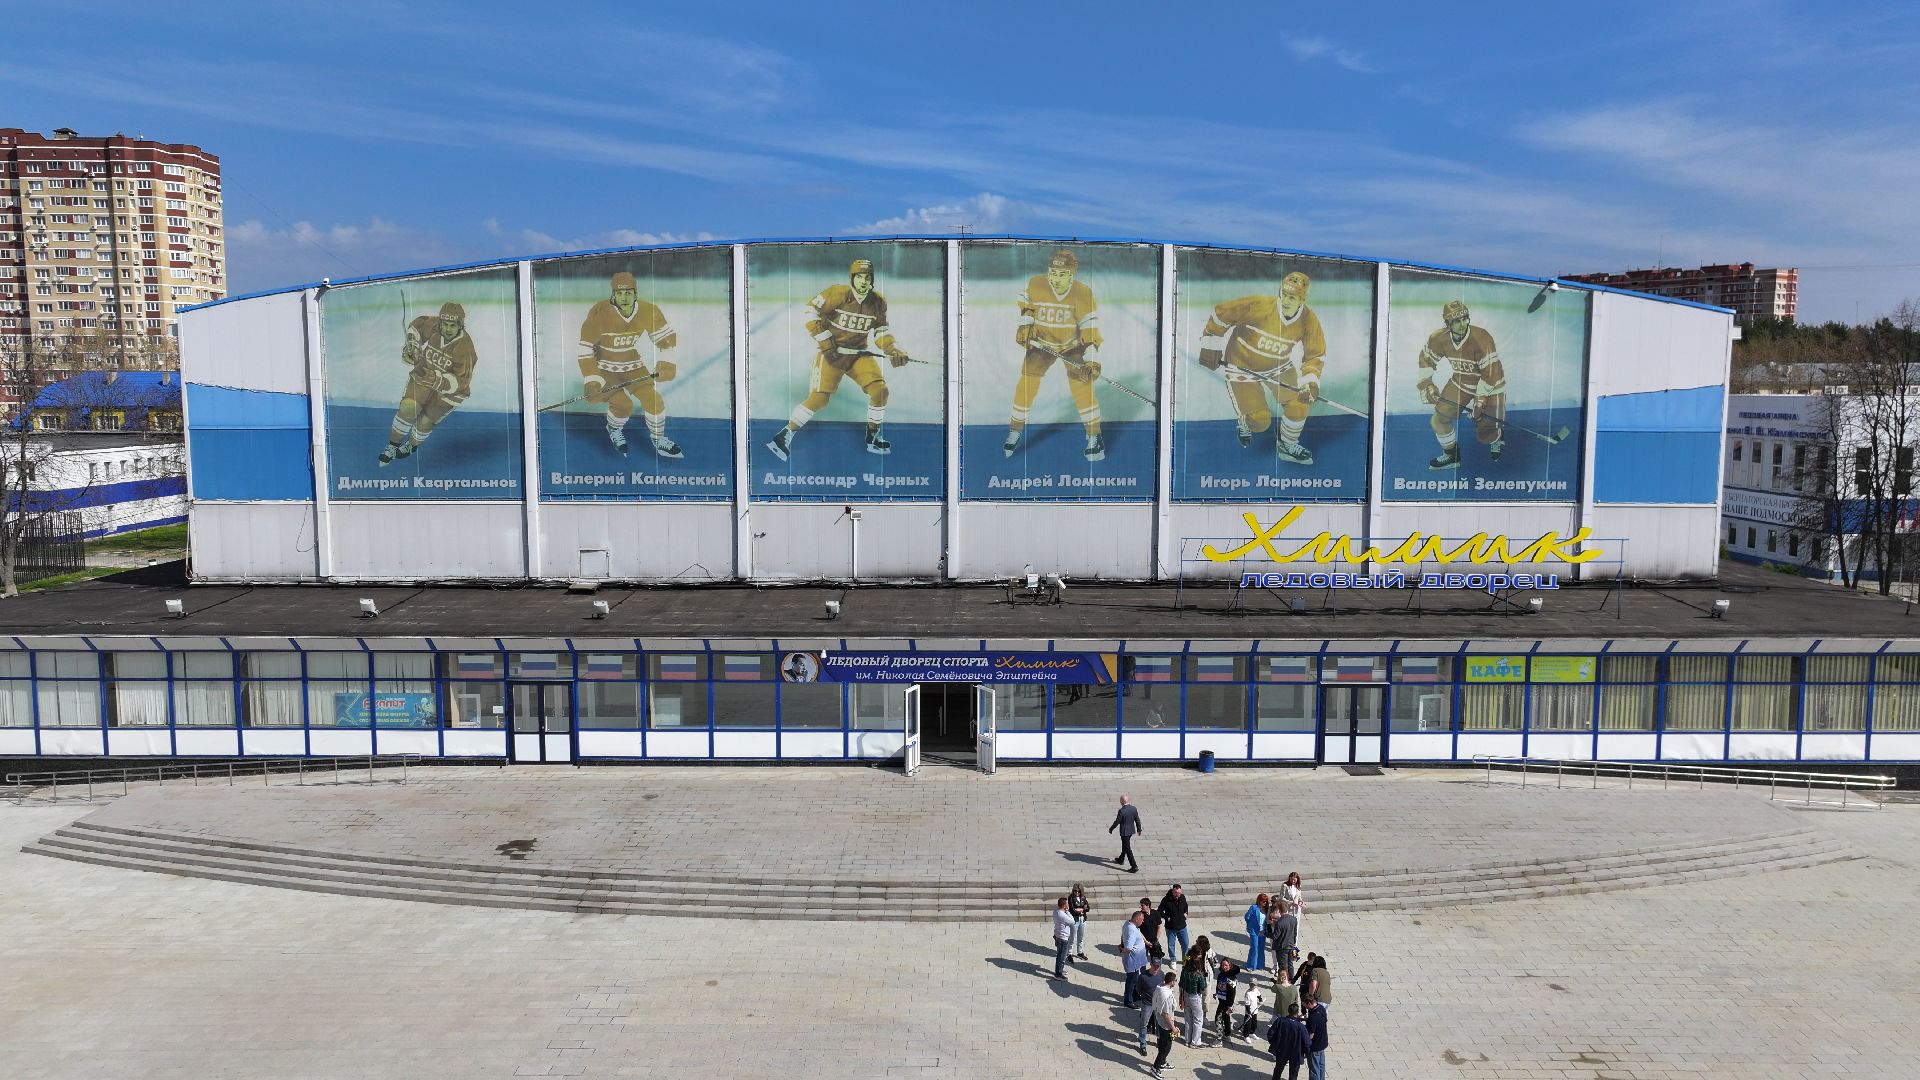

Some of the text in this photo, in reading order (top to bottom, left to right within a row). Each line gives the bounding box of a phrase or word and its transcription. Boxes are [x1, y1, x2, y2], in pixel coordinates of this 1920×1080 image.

[838, 313, 872, 331] СССР
[1037, 306, 1071, 323] СССР
[1257, 336, 1289, 355] СССР
[425, 349, 453, 369] СССР
[1451, 360, 1475, 373] СССР
[338, 476, 517, 491] Дмитрий Квартальнов
[551, 471, 727, 487] Валерий Каменский
[763, 472, 930, 489] Александр Черных
[987, 474, 1137, 491] Андрей Ломакин
[1200, 475, 1342, 491] Игорь Ларионов
[1394, 477, 1567, 493] Валерий Зелепукин
[1202, 505, 1603, 564] Химик
[1239, 569, 1560, 593] ледовый дворец
[826, 655, 890, 668] ЛЕДОВЫЙ
[891, 656, 941, 668] ДВОРЕЦ
[943, 657, 989, 667] СПОРТА
[856, 670, 1057, 680] им. Николая Семёновича Эпштейна
[1470, 664, 1522, 678] КАФЕ
